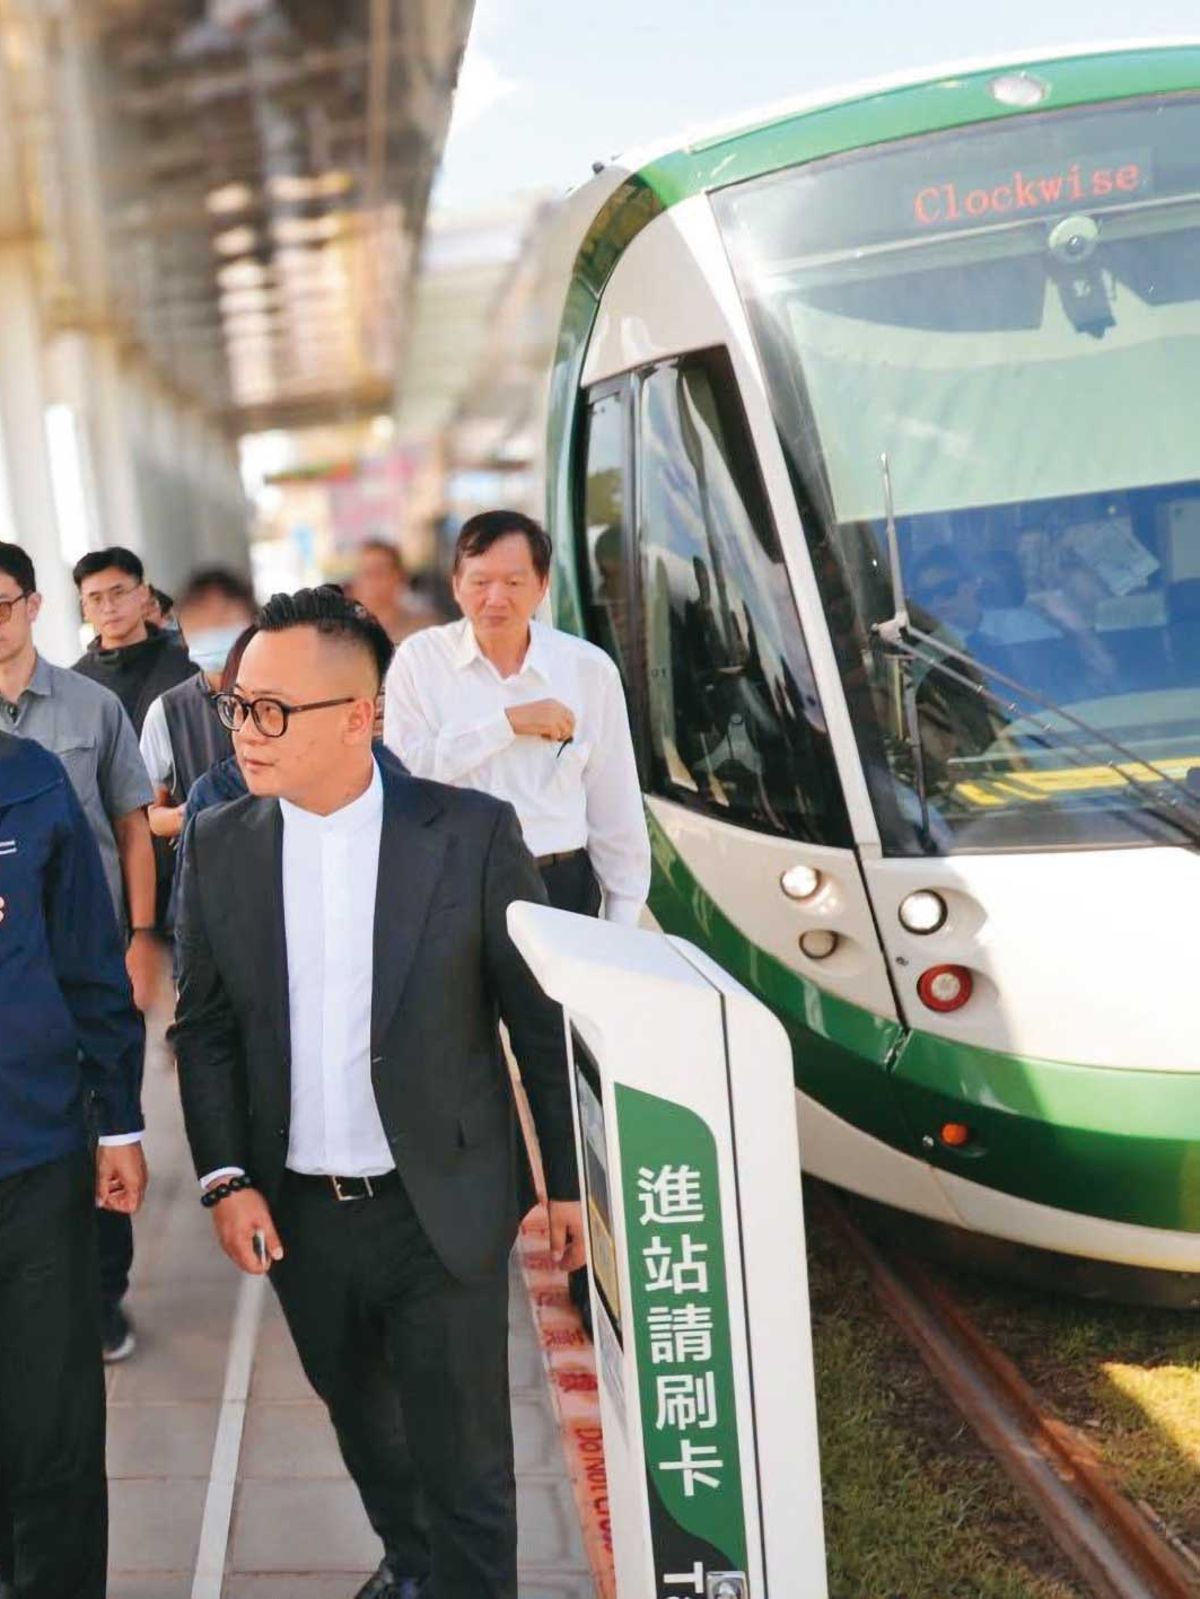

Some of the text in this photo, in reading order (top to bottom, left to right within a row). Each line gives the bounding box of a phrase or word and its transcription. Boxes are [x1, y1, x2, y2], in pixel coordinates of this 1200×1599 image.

[914, 163, 1139, 224] Clockwise
[638, 1164, 723, 1496] 進站請刷卡
[575, 1428, 602, 1452] DO
